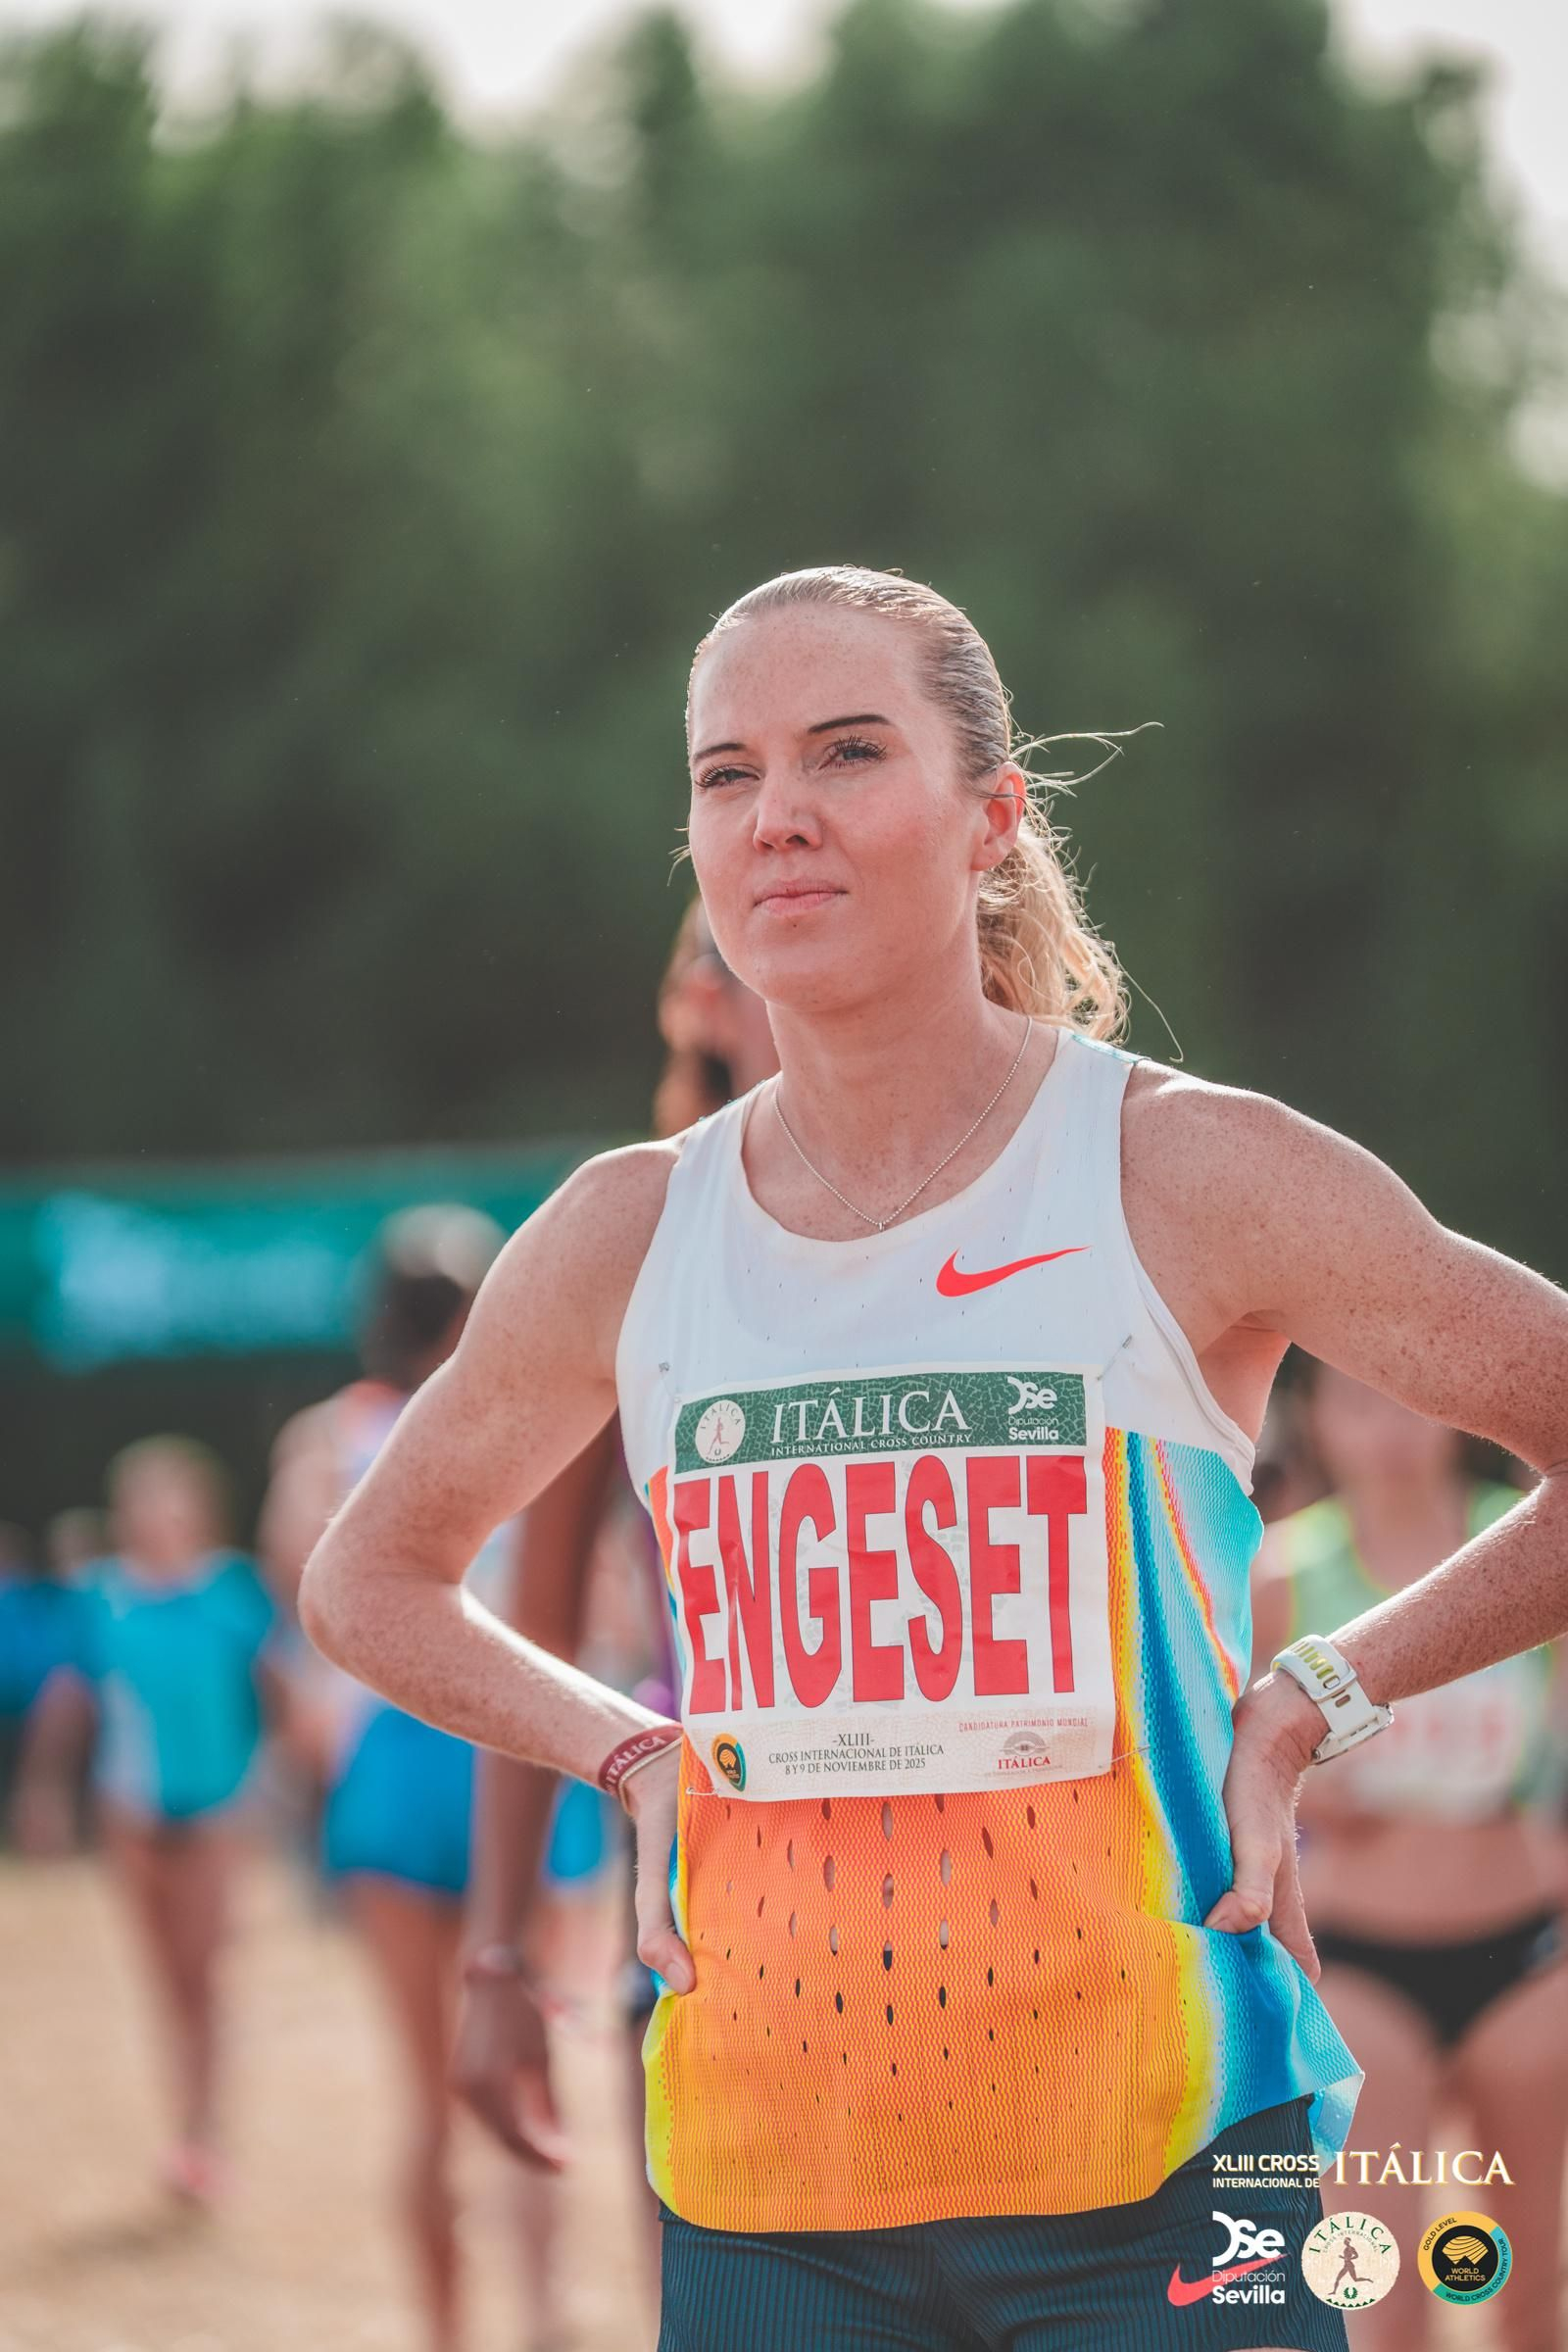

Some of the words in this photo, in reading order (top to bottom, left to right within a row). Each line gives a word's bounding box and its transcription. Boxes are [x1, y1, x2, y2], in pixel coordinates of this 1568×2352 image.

[770, 1387, 972, 1444] ITÁLICA
[1007, 1426, 1059, 1441] Sevilla
[771, 1441, 866, 1457] INTERNATIONAL
[870, 1437, 907, 1449] CROSS
[911, 1434, 971, 1446] COUNTRY
[673, 1454, 1088, 1715] ENGESET
[768, 1751, 799, 1764] CROSS
[801, 1747, 887, 1762] INTERNACIONAL
[889, 1746, 902, 1758] DE
[998, 1756, 1051, 1770] ITÁLICA
[785, 1764, 791, 1776] 8
[792, 1764, 799, 1775] Y
[800, 1763, 806, 1773] 9
[808, 1762, 821, 1774] DE
[823, 1760, 887, 1773] NOVIEMBRE
[889, 1759, 902, 1771] DE
[905, 1757, 926, 1770] 2025
